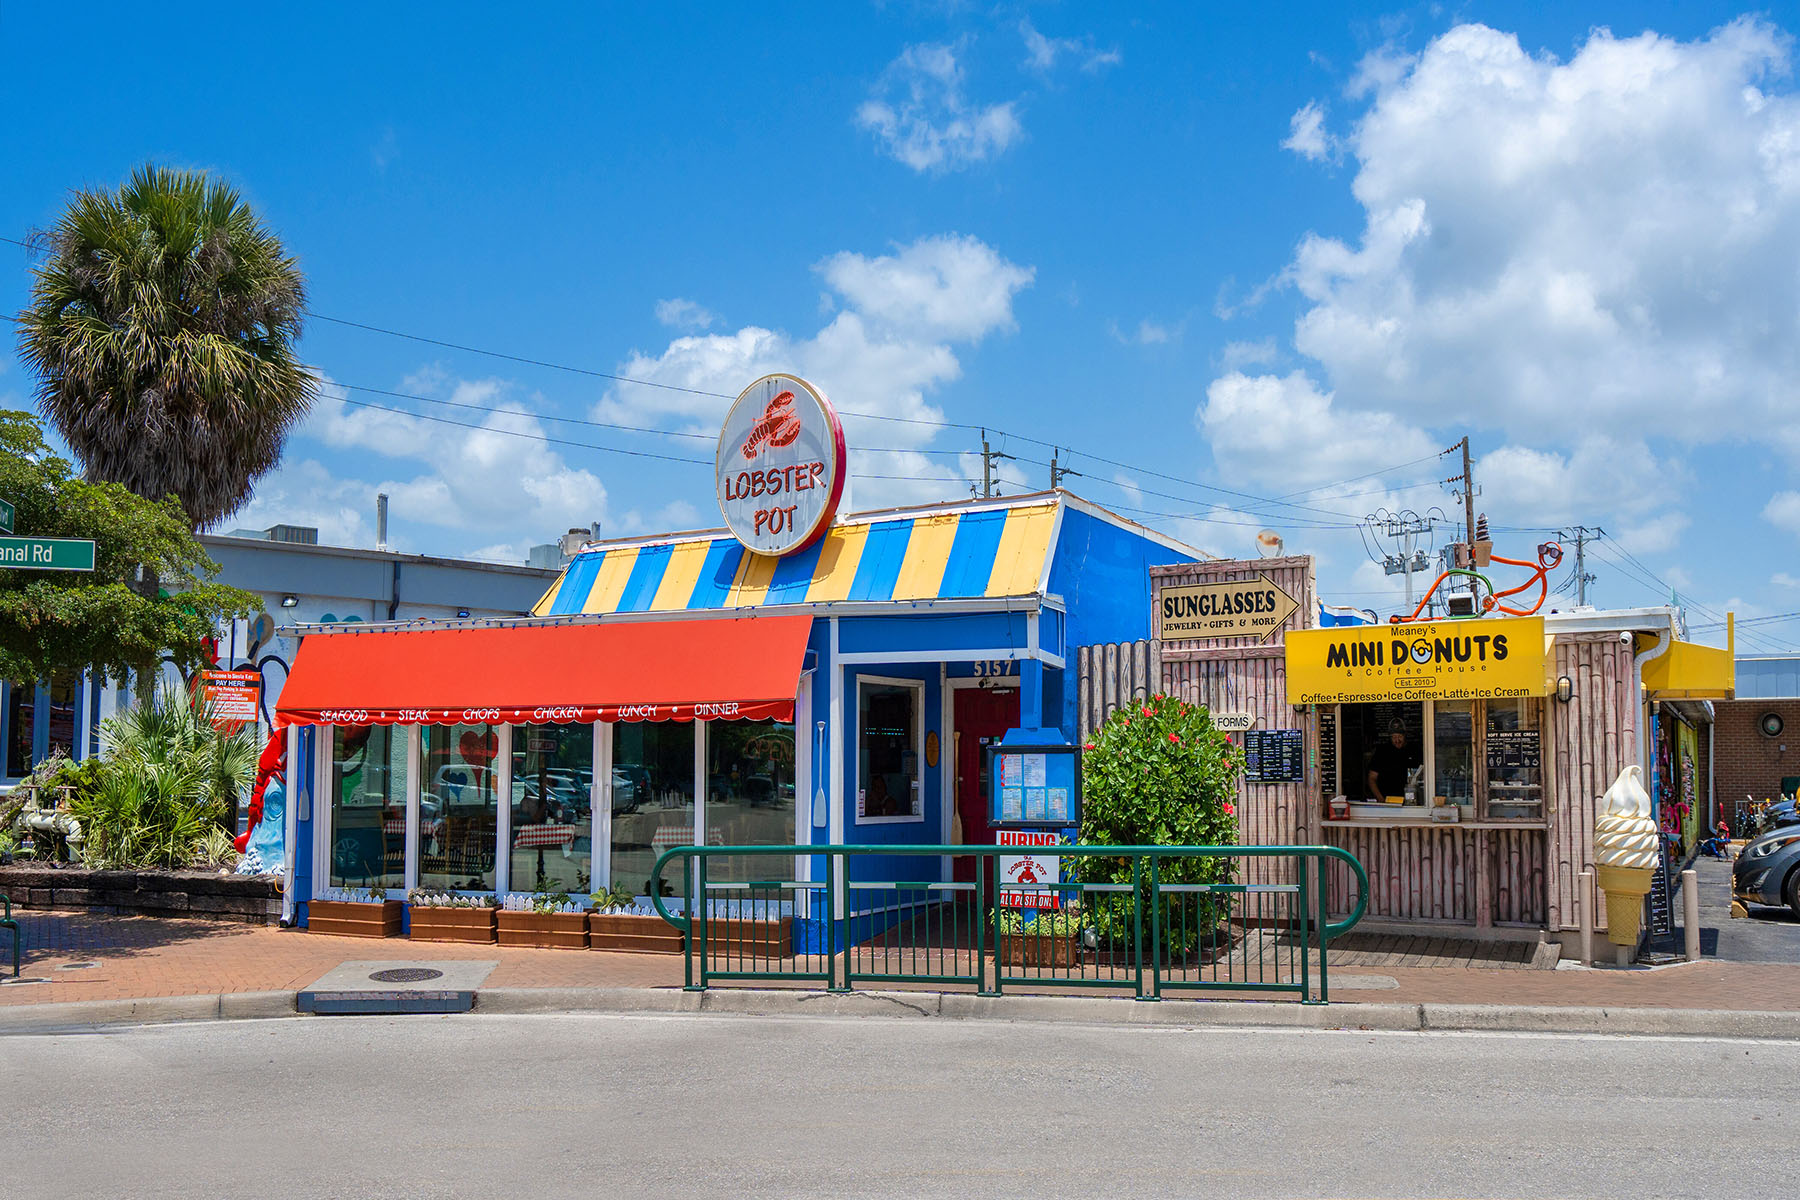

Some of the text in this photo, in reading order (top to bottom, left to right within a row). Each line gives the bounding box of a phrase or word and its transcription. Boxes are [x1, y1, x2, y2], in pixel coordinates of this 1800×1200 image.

[725, 461, 827, 501] LOBSTER
[754, 505, 797, 536] POT
[33, 544, 53, 562] Rd
[1163, 590, 1276, 619] SUNGLASSES
[1163, 617, 1277, 631] JEWELRY GIFTS & MORE
[1391, 625, 1437, 637] Meaney's
[1326, 634, 1509, 669] MINI DONUTS
[973, 659, 1013, 677] 5157
[1346, 664, 1487, 677] & Coffee House
[1400, 678, 1431, 687] Est. 2010
[1300, 685, 1530, 704] Coffee Espresso Ice Coffee Latté Ice Cream
[319, 702, 739, 722] SEAFOOD STEAK CHOPS CHICKEN LUNCH DINNER
[1217, 716, 1249, 728] FORMS
[1000, 832, 1056, 846] HIRING
[1008, 860, 1047, 876] LOBSTER POT
